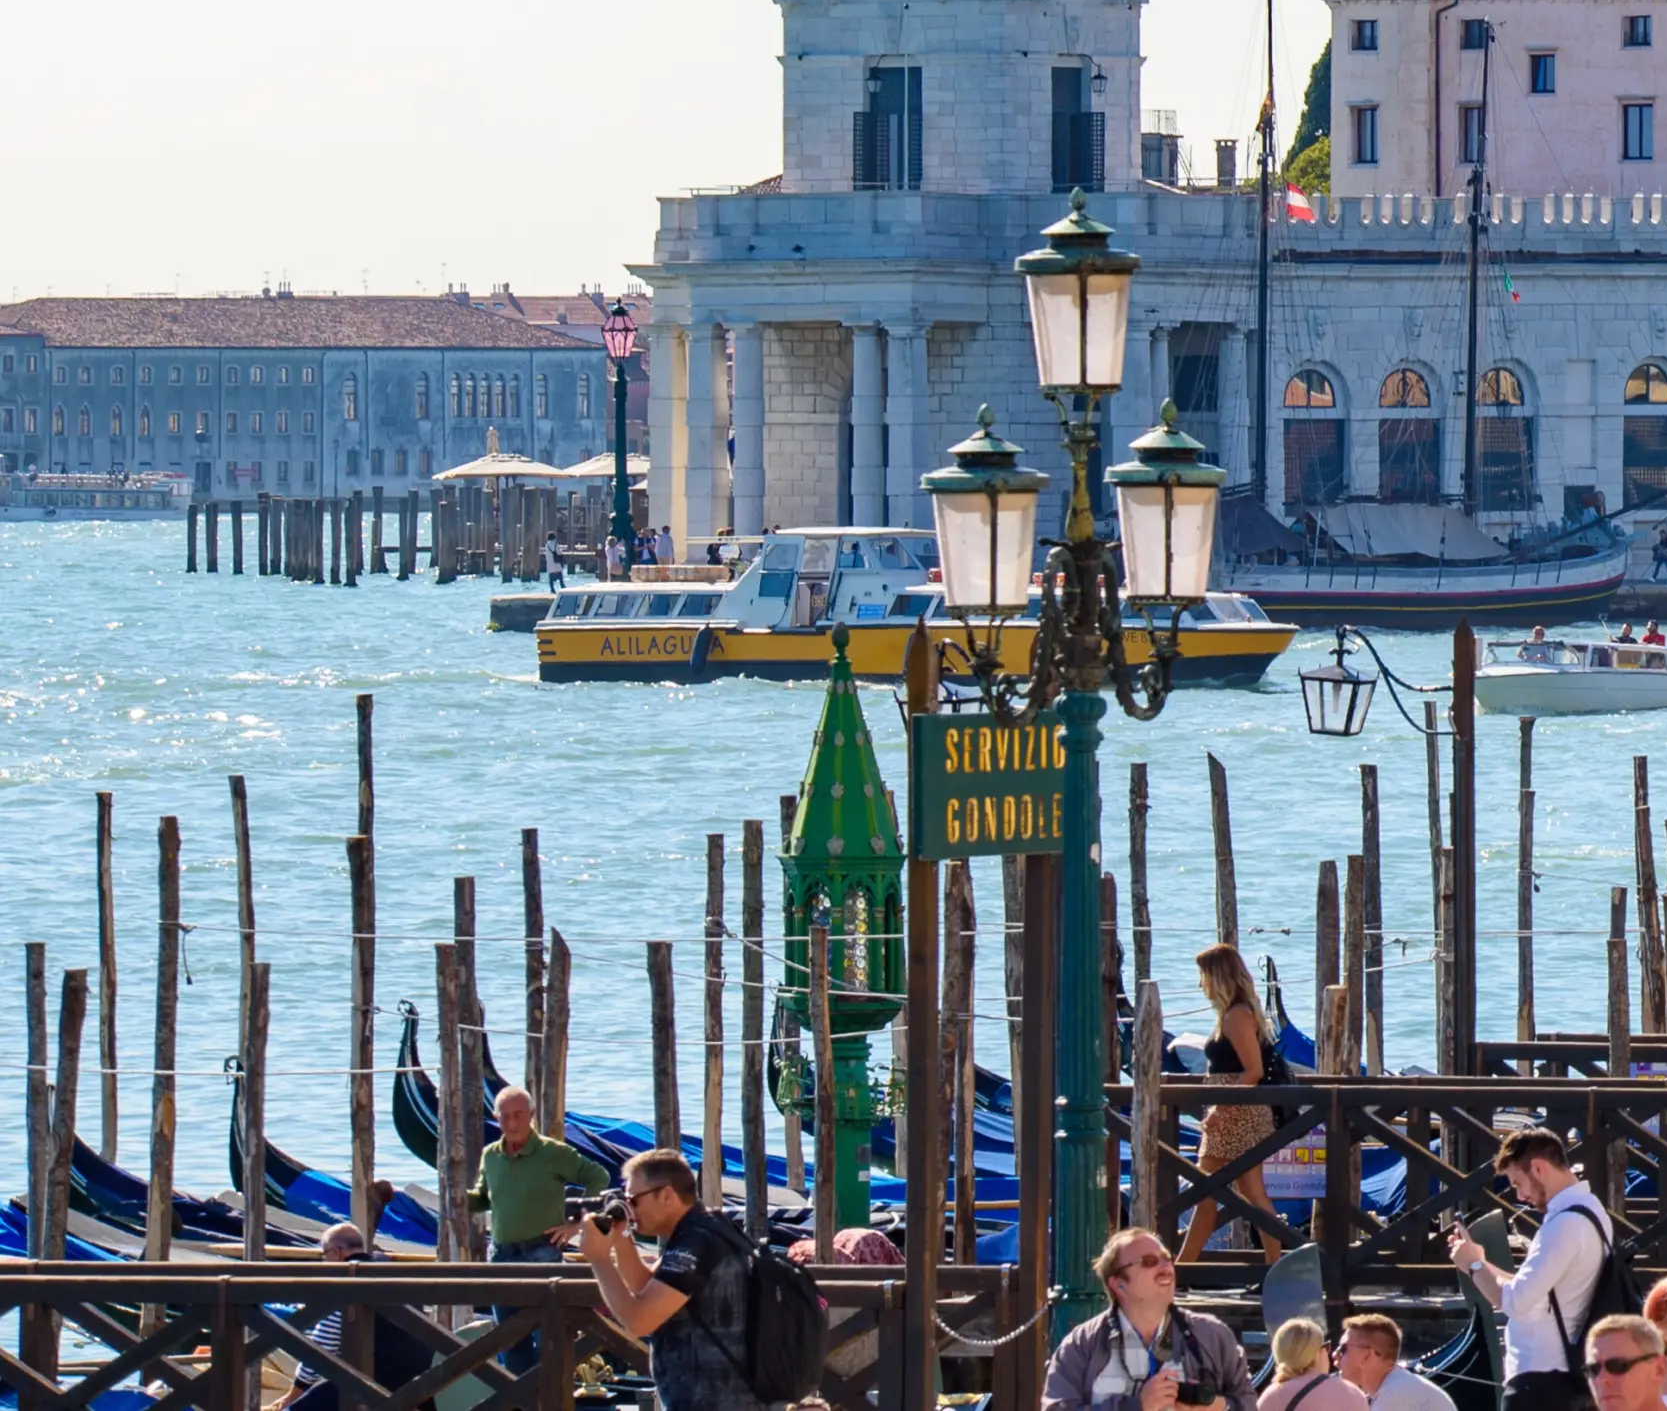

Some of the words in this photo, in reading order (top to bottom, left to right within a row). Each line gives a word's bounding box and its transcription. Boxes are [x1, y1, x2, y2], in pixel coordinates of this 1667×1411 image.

[600, 635, 725, 657] ALILAGUA
[945, 724, 1067, 774] SERVIZIO
[946, 792, 1063, 845] GONDOLE
